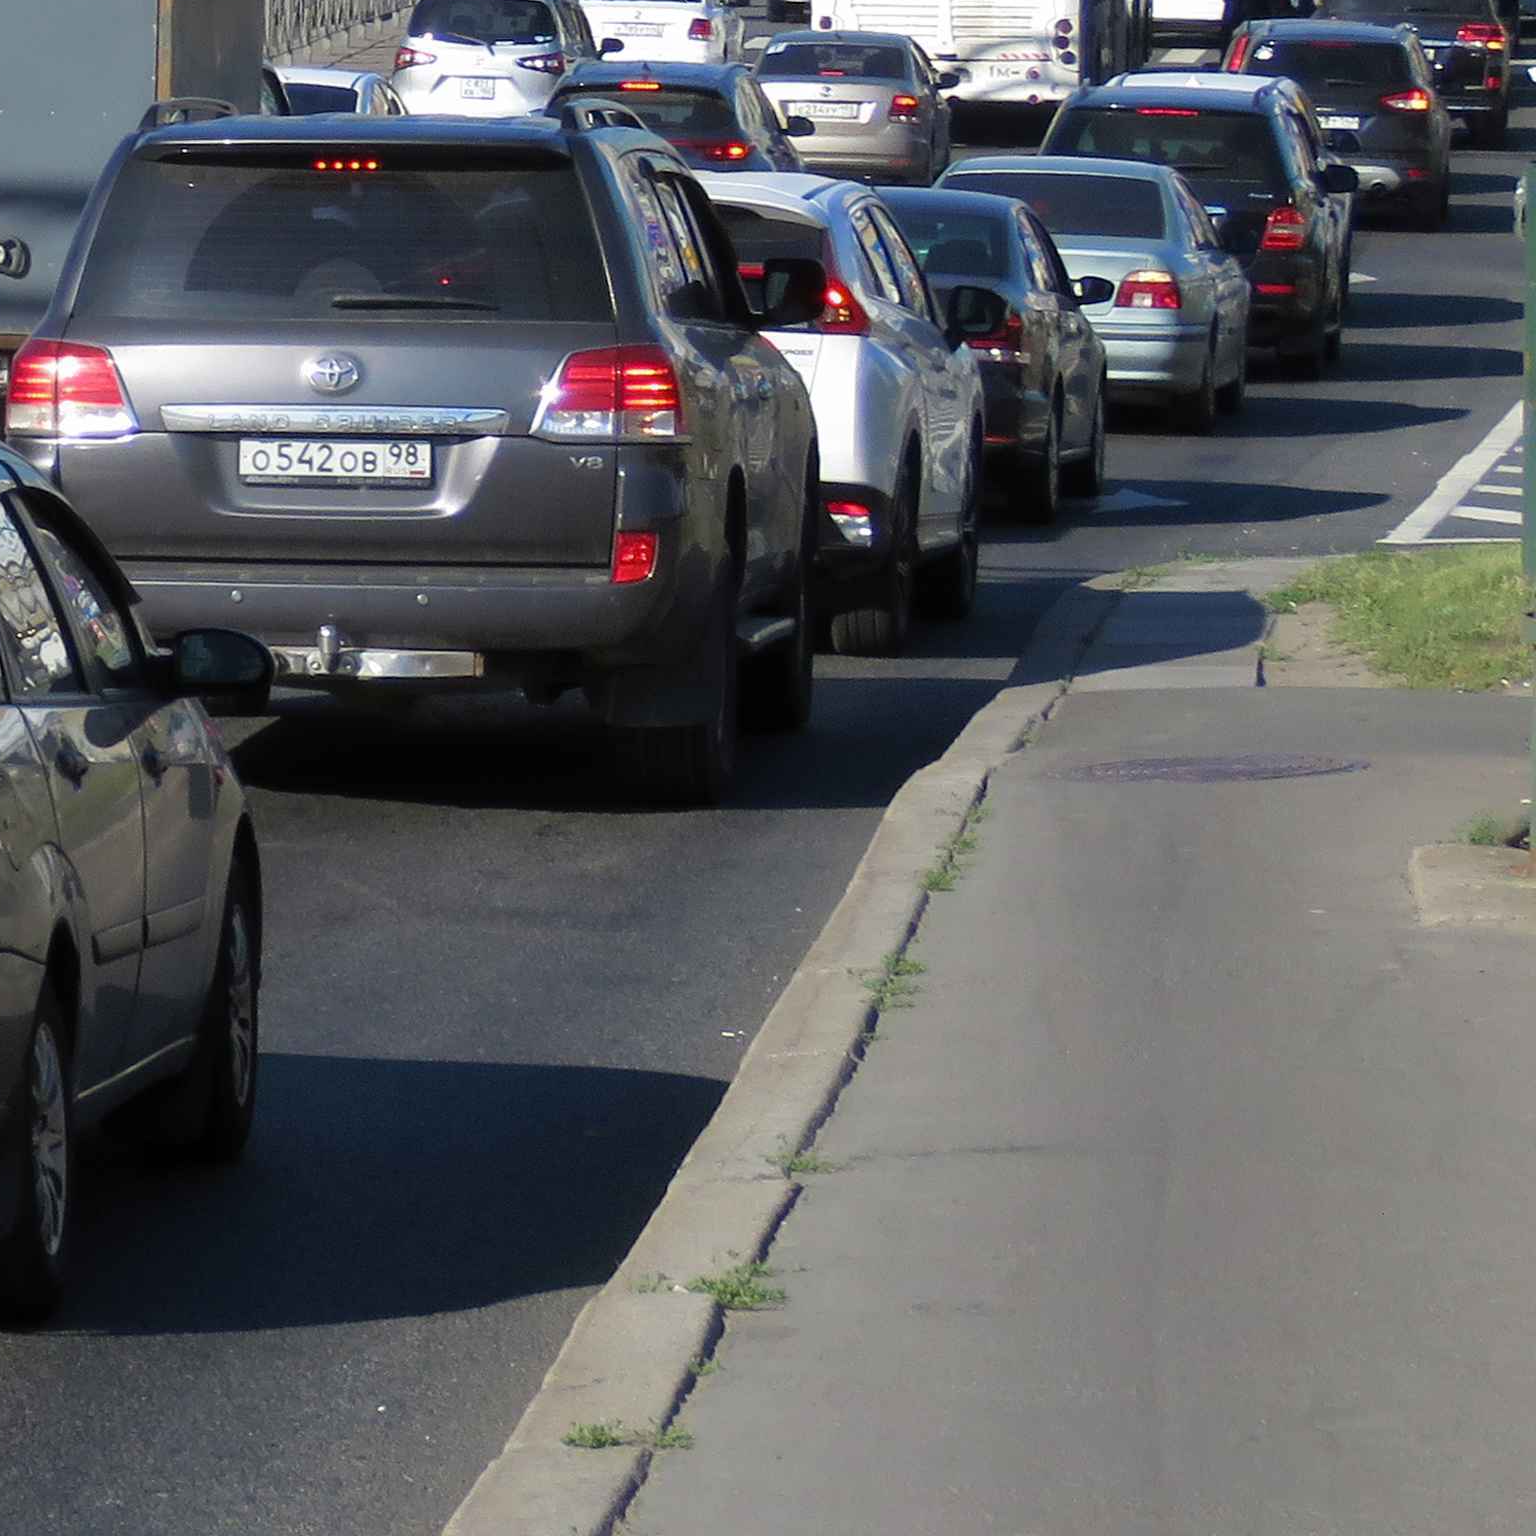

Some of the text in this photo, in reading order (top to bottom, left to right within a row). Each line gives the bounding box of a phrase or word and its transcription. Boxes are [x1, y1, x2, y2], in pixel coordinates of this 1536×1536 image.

[208, 413, 461, 432] LAND CRUISER
[252, 442, 419, 474] О542ОВ 98
